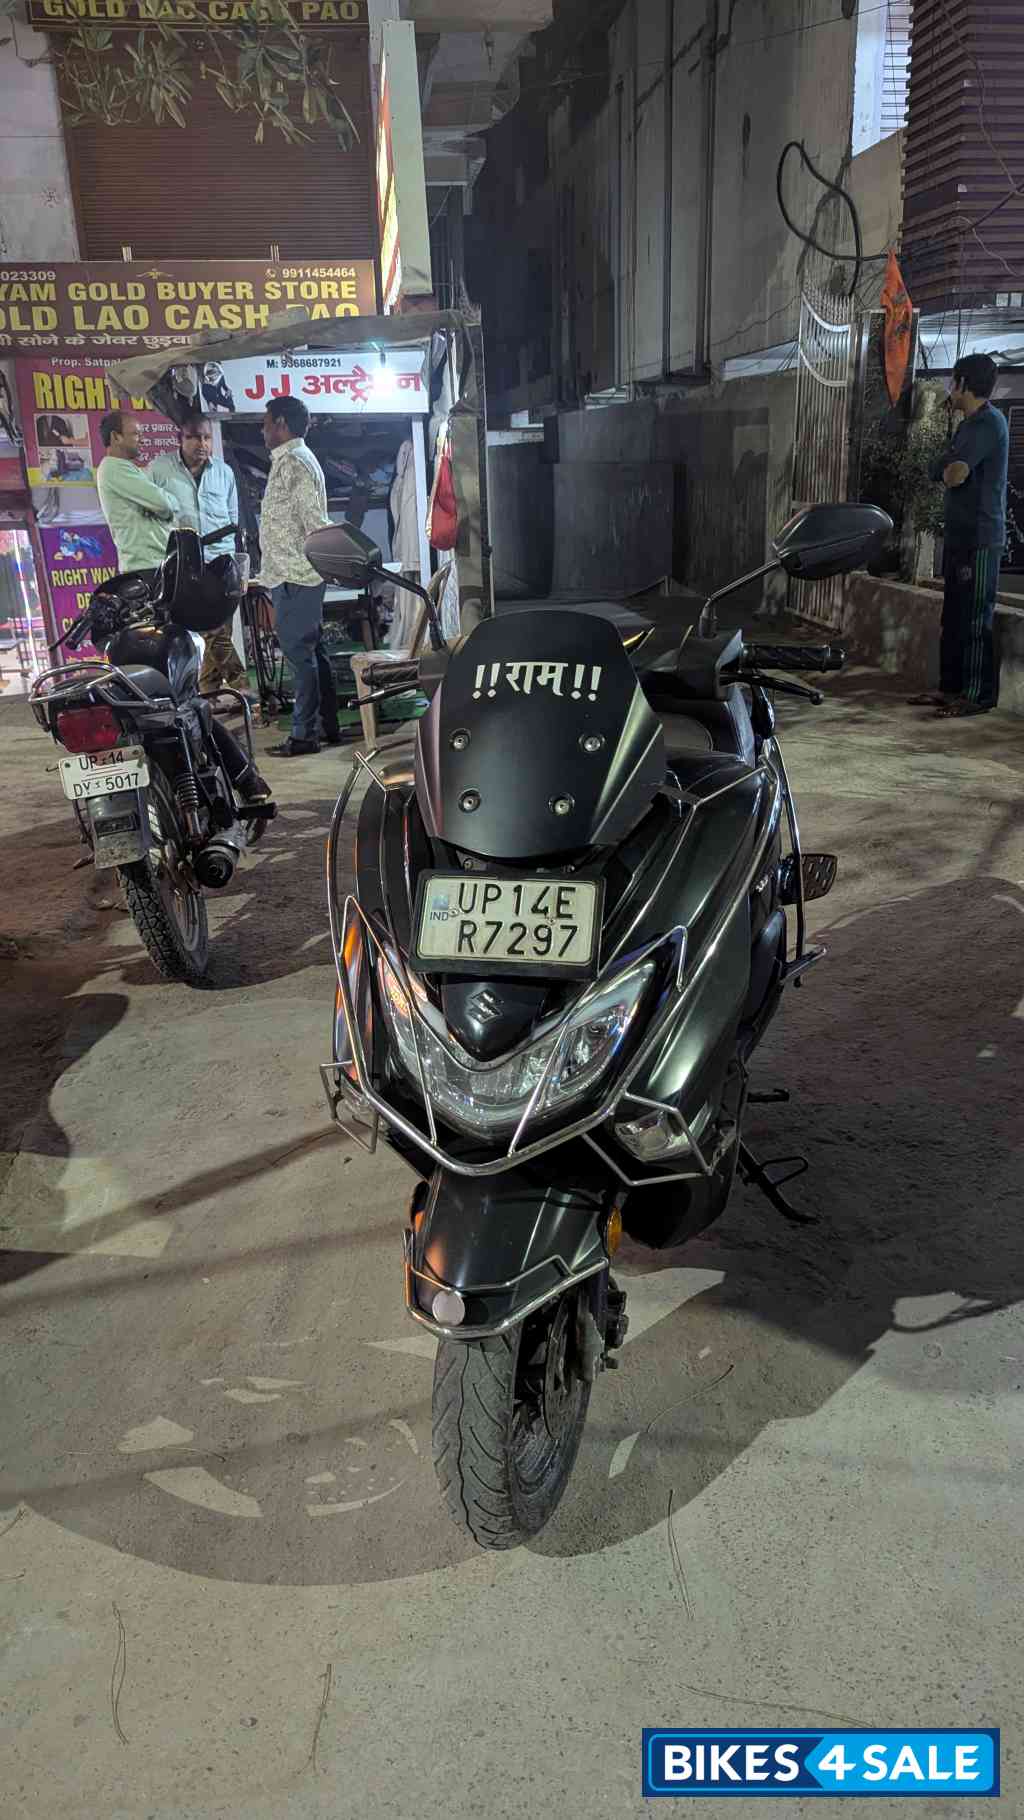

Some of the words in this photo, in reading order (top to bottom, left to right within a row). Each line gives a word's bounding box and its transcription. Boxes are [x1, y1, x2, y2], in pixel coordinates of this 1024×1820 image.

[302, 2, 360, 20] PAO
[282, 268, 356, 278] 9911454464
[67, 282, 146, 300] GOLD
[156, 281, 254, 300] BUYER
[264, 281, 357, 300] STORE
[0, 304, 58, 331] LD
[73, 304, 150, 330] LAO
[164, 303, 269, 330] CASH
[51, 357, 81, 367] Prop.
[51, 569, 88, 586] RIGHT
[109, 750, 124, 764] 14
[105, 773, 139, 791] 5017
[430, 911, 449, 921] IND
[457, 919, 579, 957] R7297
